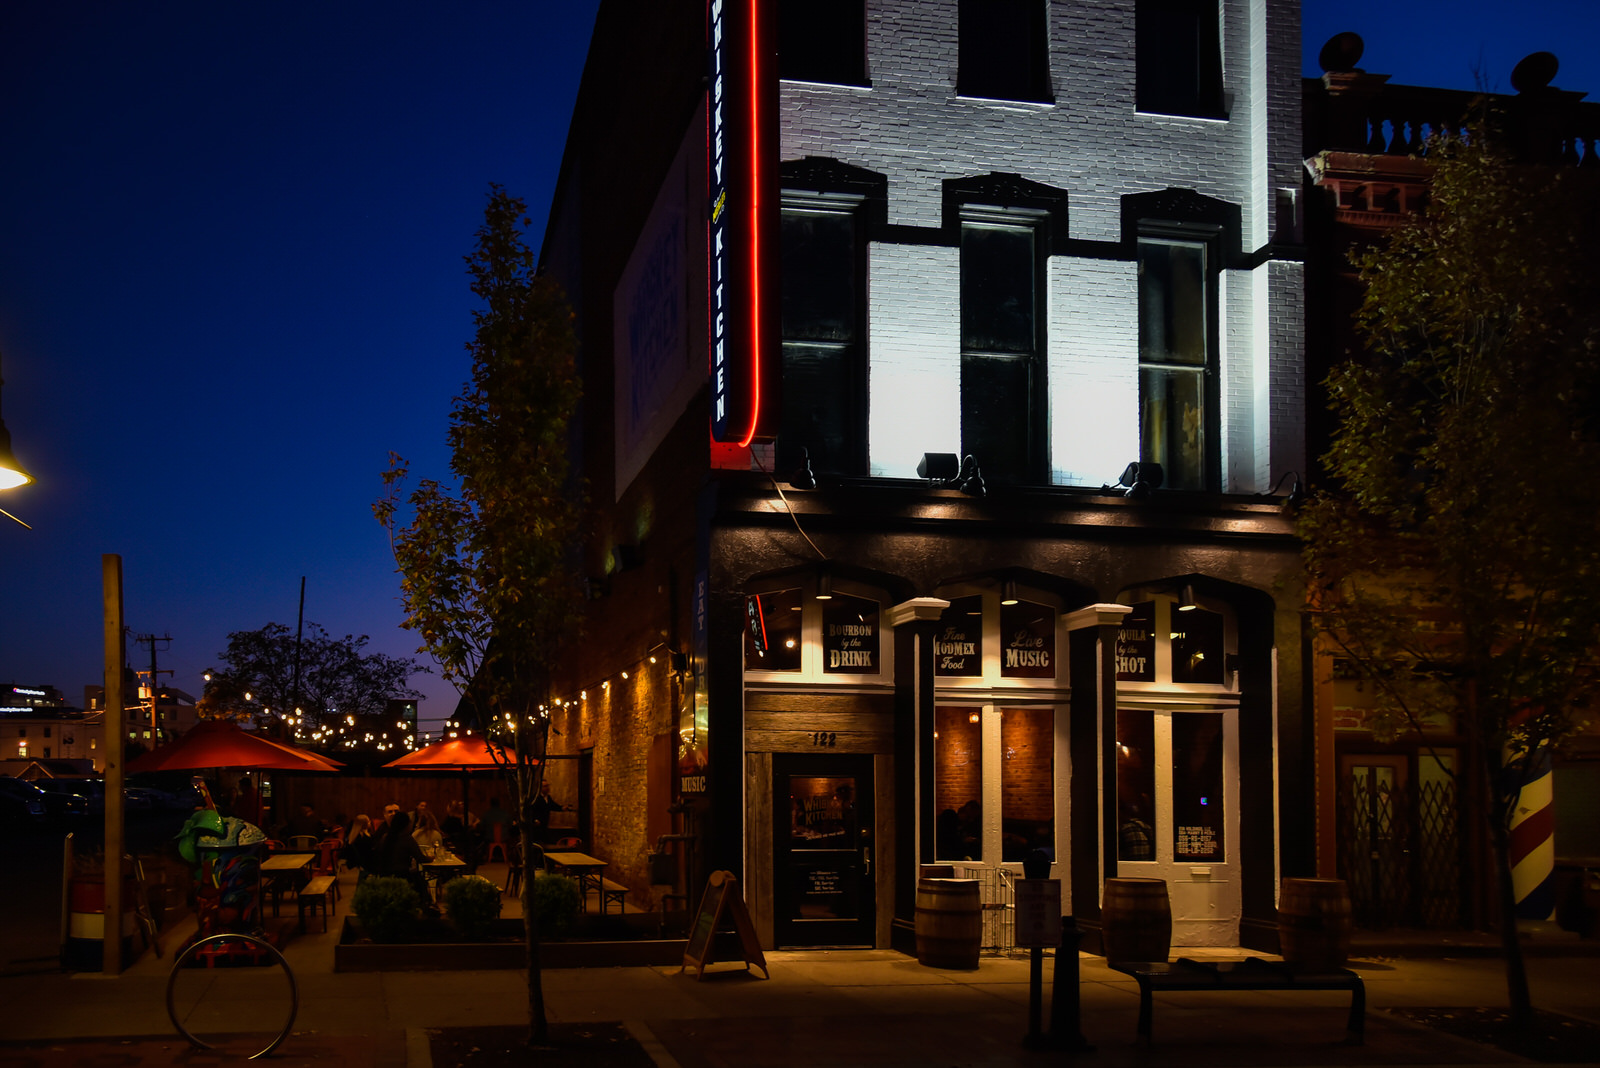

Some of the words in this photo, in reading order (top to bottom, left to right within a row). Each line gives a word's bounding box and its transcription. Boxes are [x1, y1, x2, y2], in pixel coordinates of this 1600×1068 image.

[712, 0, 724, 185] WHISKEY
[714, 226, 725, 422] KITCHEN
[829, 623, 872, 637] BOURBON
[943, 626, 966, 641] Fine
[1117, 629, 1146, 643] QUILA
[841, 637, 849, 650] by
[850, 637, 861, 647] the
[1010, 630, 1044, 648] Live
[830, 649, 872, 668] DRINK
[941, 656, 965, 670] Food
[1005, 648, 1049, 668] MUSIC
[813, 732, 836, 747] 122
[681, 776, 706, 792] MUSIC
